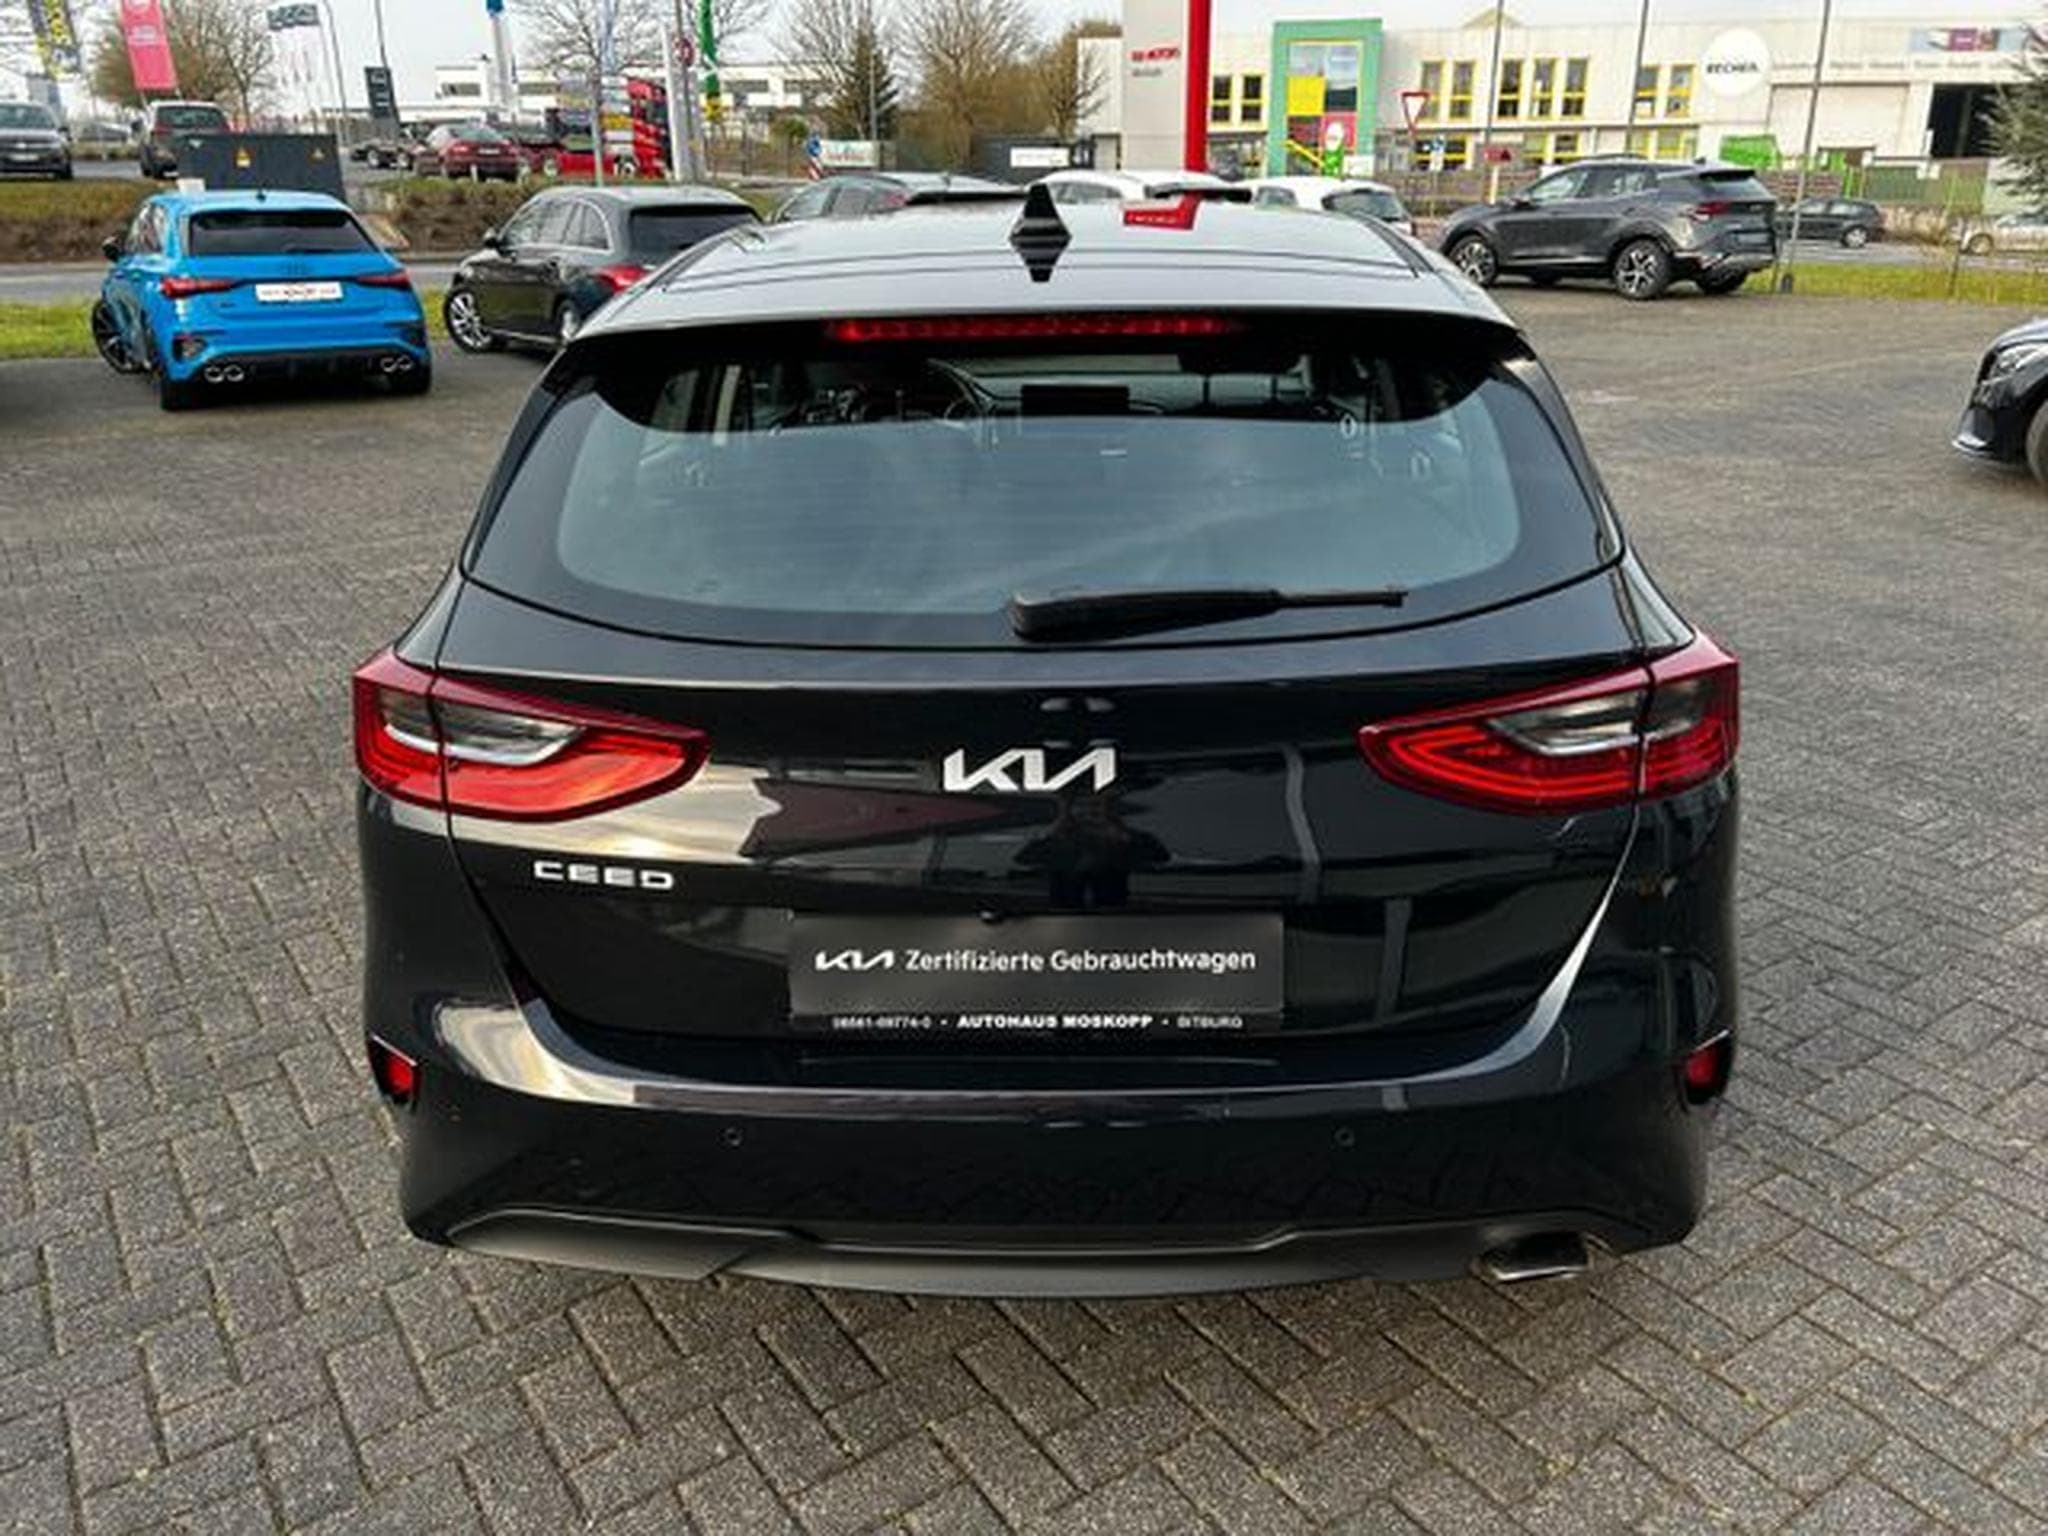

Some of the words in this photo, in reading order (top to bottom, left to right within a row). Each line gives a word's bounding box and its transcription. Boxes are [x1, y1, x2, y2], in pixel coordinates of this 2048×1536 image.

[943, 748, 1116, 792] KIA
[533, 860, 675, 892] CEED
[814, 948, 895, 973] KIA
[905, 948, 1044, 973] Zertifizierte
[1049, 948, 1256, 975] Gebrauchtwagen
[956, 1013, 1058, 1029] AUTOHAUS
[1061, 1013, 1153, 1029] MOSKOPP
